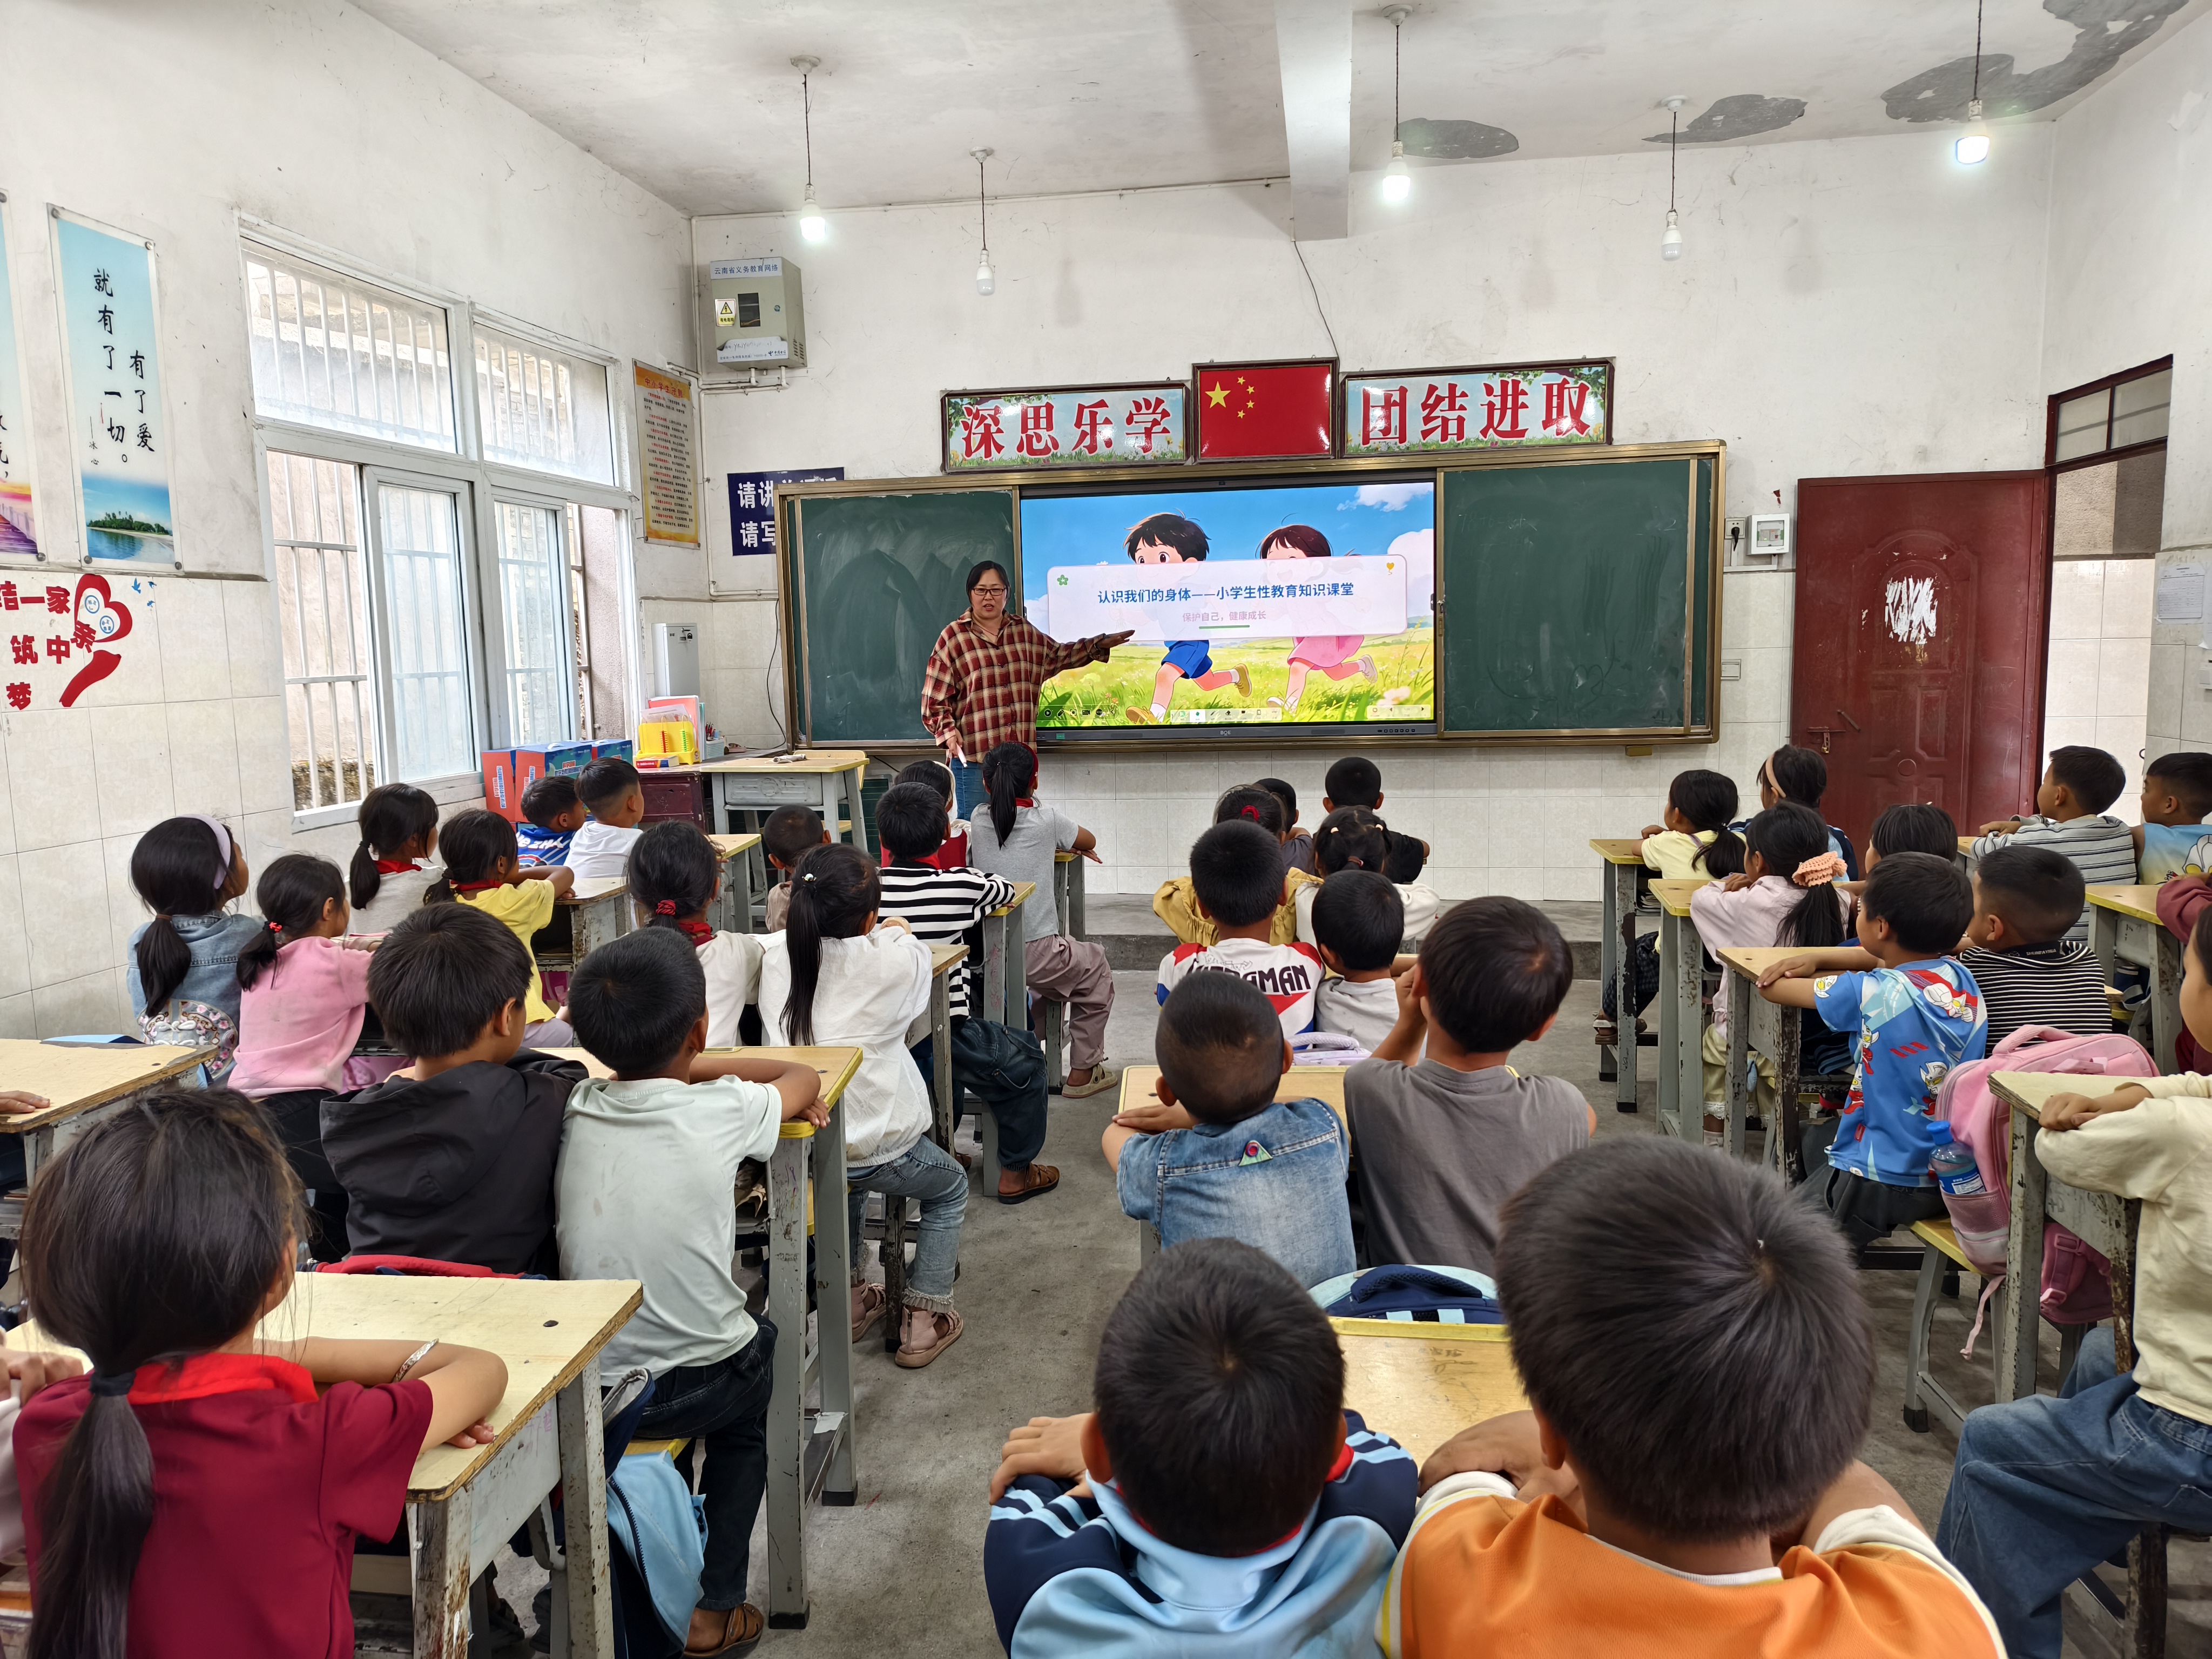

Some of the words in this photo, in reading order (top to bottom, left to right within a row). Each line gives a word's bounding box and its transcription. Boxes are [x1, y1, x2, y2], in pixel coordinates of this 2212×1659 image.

[714, 264, 778, 274] 云南省义务教育网络
[130, 350, 155, 452] 有了爱
[644, 377, 683, 398] 中小学生守则
[1361, 377, 1590, 446] 团结进取
[961, 396, 1171, 459] 深思乐学
